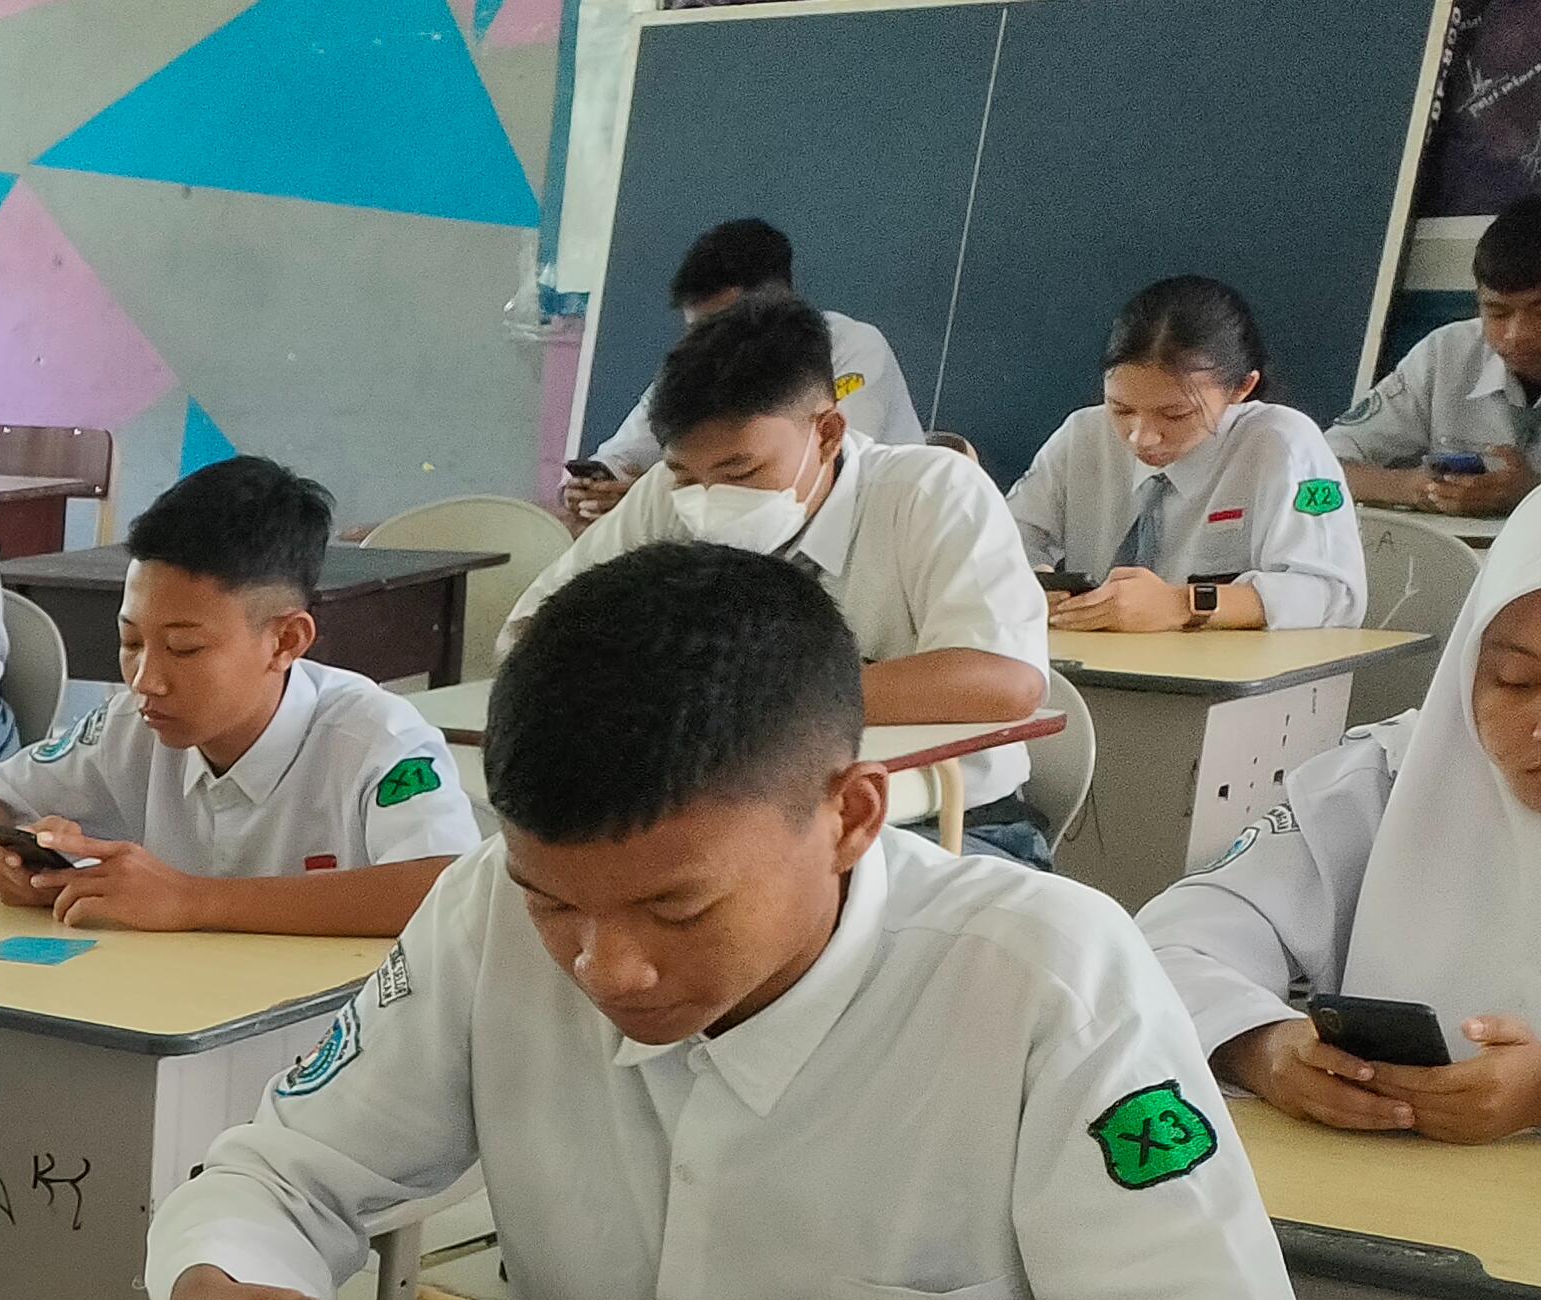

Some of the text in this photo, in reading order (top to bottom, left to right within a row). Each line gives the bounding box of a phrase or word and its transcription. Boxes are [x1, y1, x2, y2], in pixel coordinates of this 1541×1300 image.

[1306, 487, 1330, 507] X2
[388, 767, 424, 797] X1
[1119, 1109, 1192, 1167] X3
